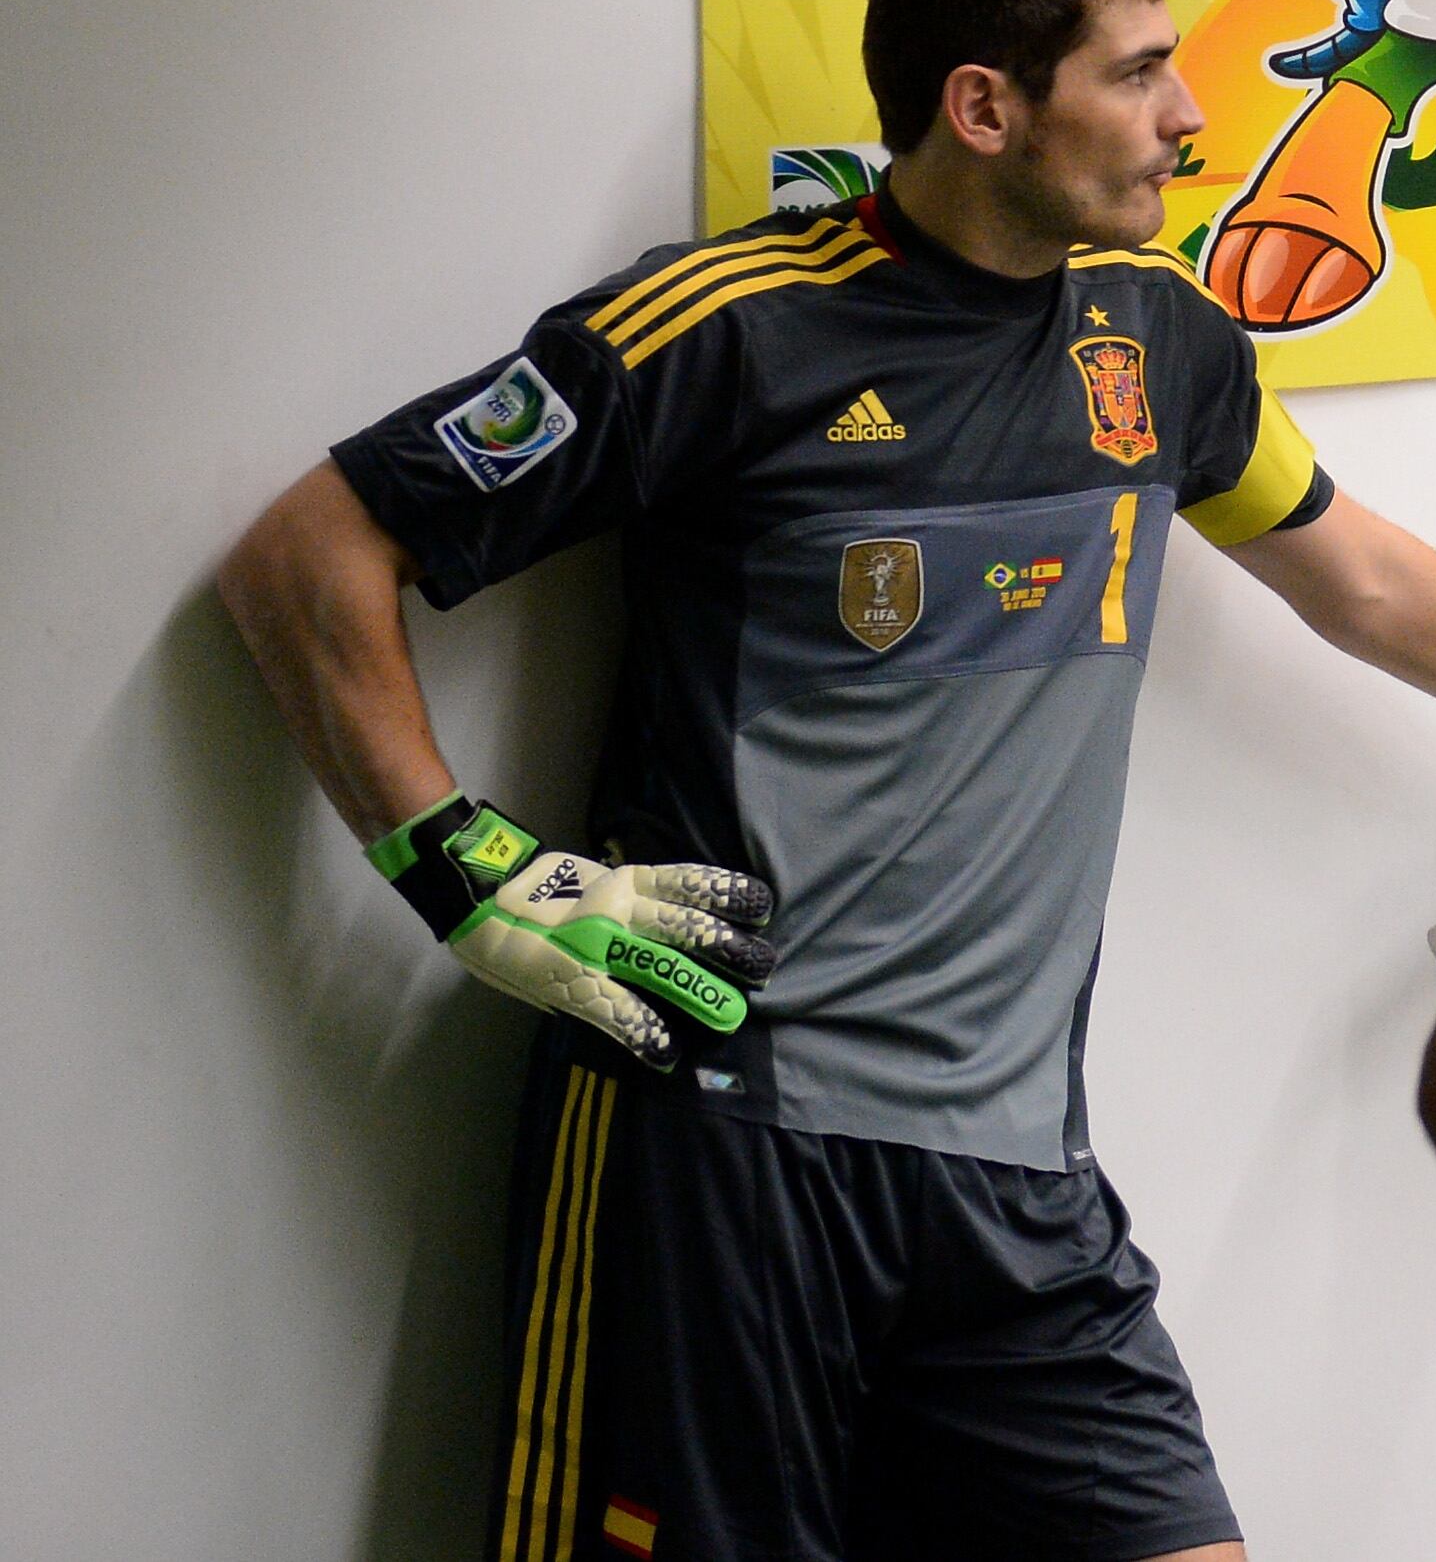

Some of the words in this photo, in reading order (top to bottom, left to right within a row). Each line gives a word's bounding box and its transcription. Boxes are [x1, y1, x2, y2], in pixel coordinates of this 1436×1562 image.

[827, 421, 906, 443] adidas
[477, 456, 502, 483] FIFA
[1099, 492, 1140, 645] 1
[863, 609, 899, 622] FIFA
[528, 858, 576, 903] adidas
[605, 936, 731, 1012] predator
